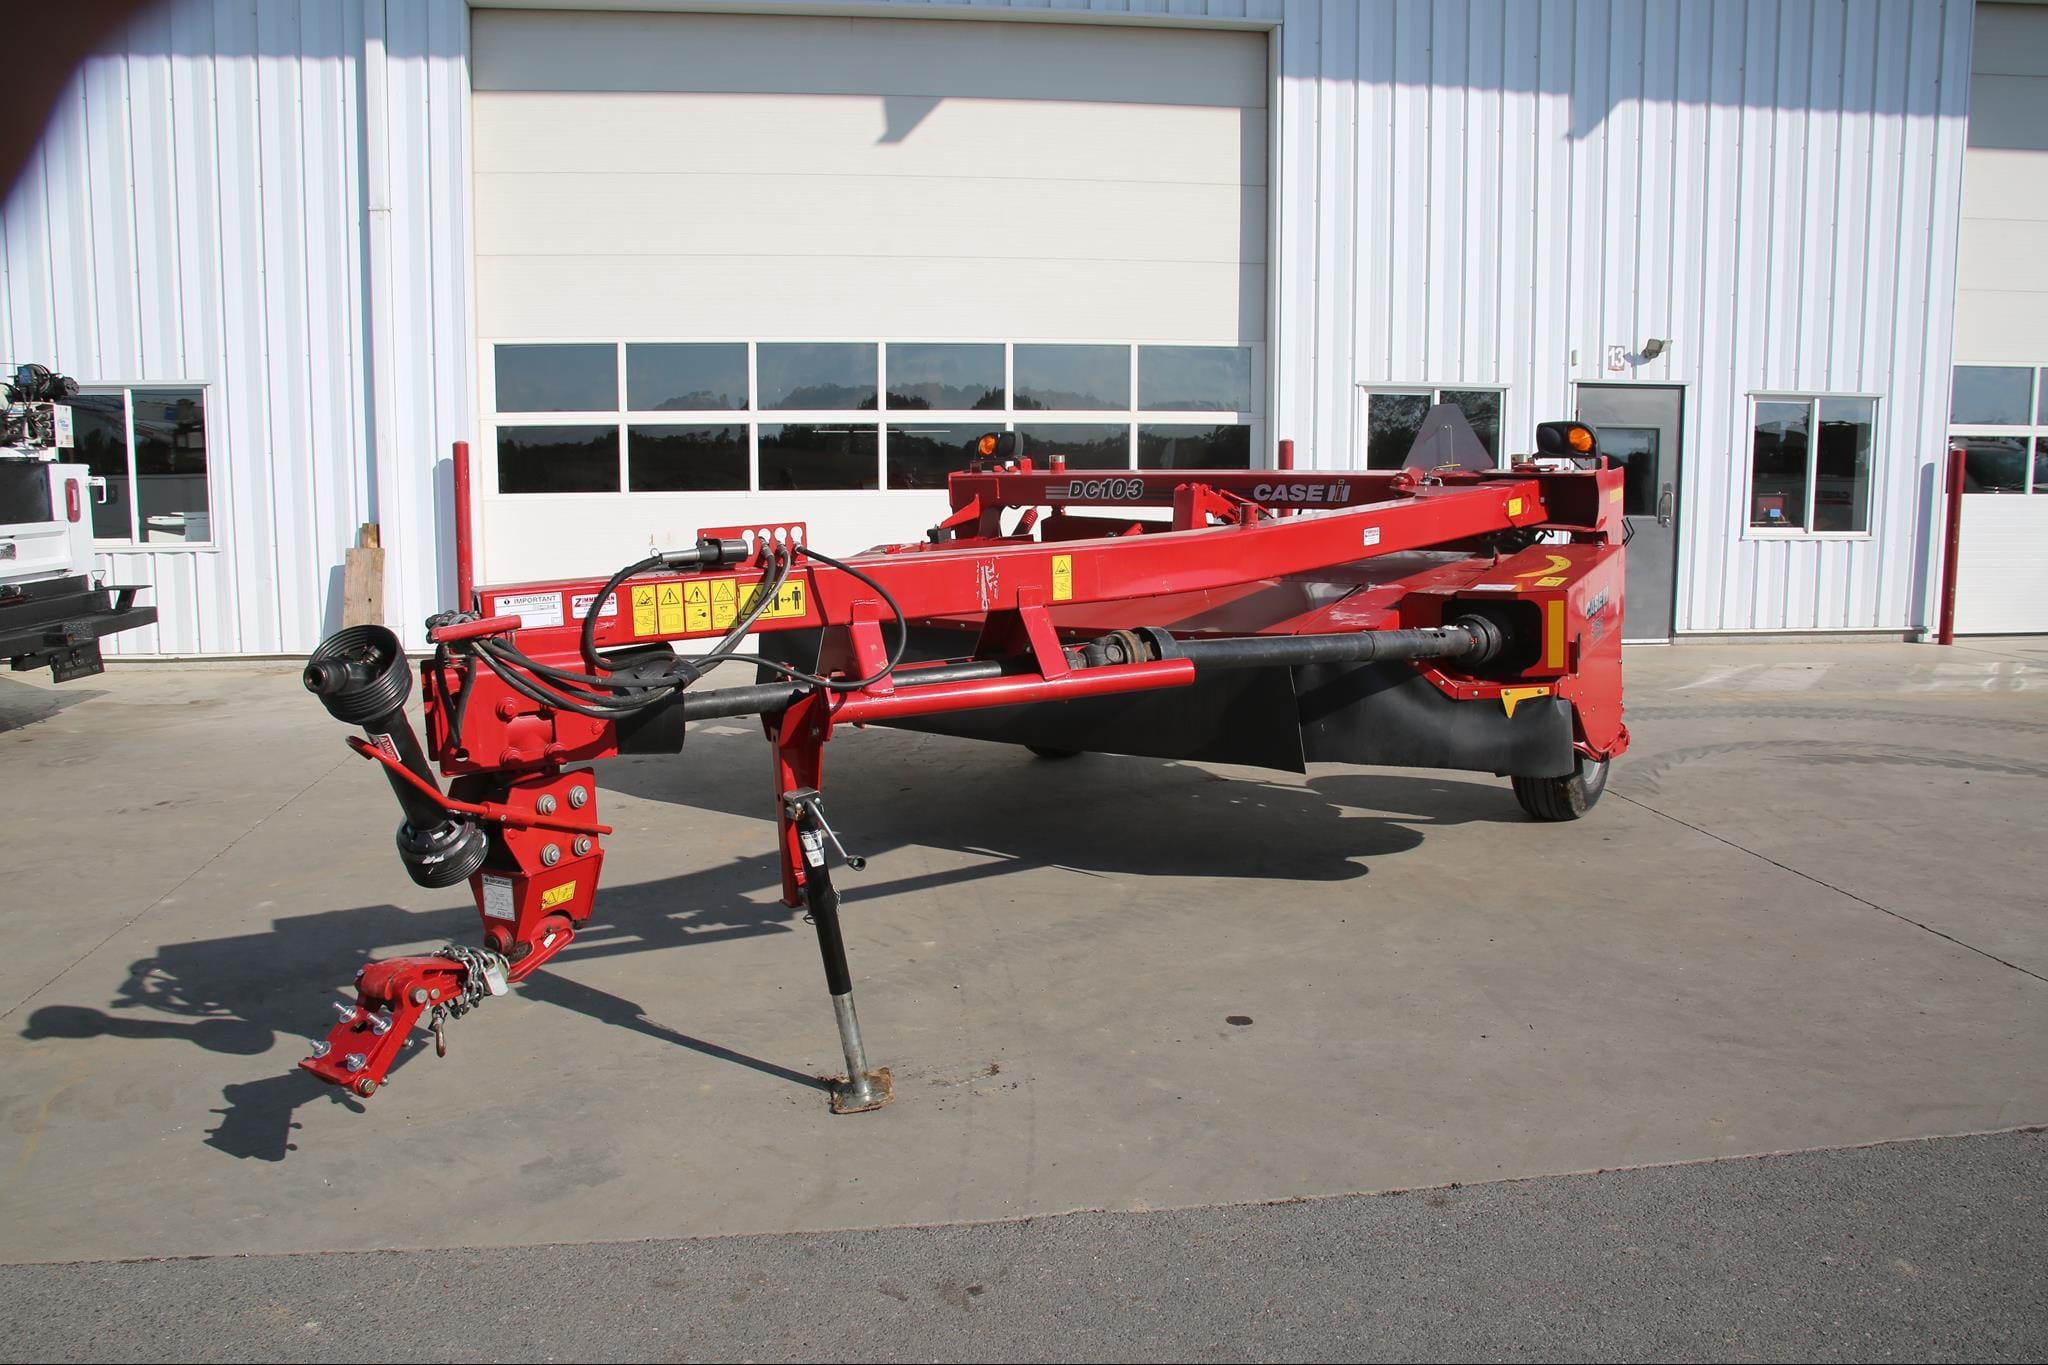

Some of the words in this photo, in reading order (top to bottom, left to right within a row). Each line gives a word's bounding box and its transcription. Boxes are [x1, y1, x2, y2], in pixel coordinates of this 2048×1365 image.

[1608, 346, 1625, 368] 13
[1068, 479, 1144, 499] DC103
[1253, 483, 1325, 502] CASE
[514, 595, 556, 604] IMPORTANT
